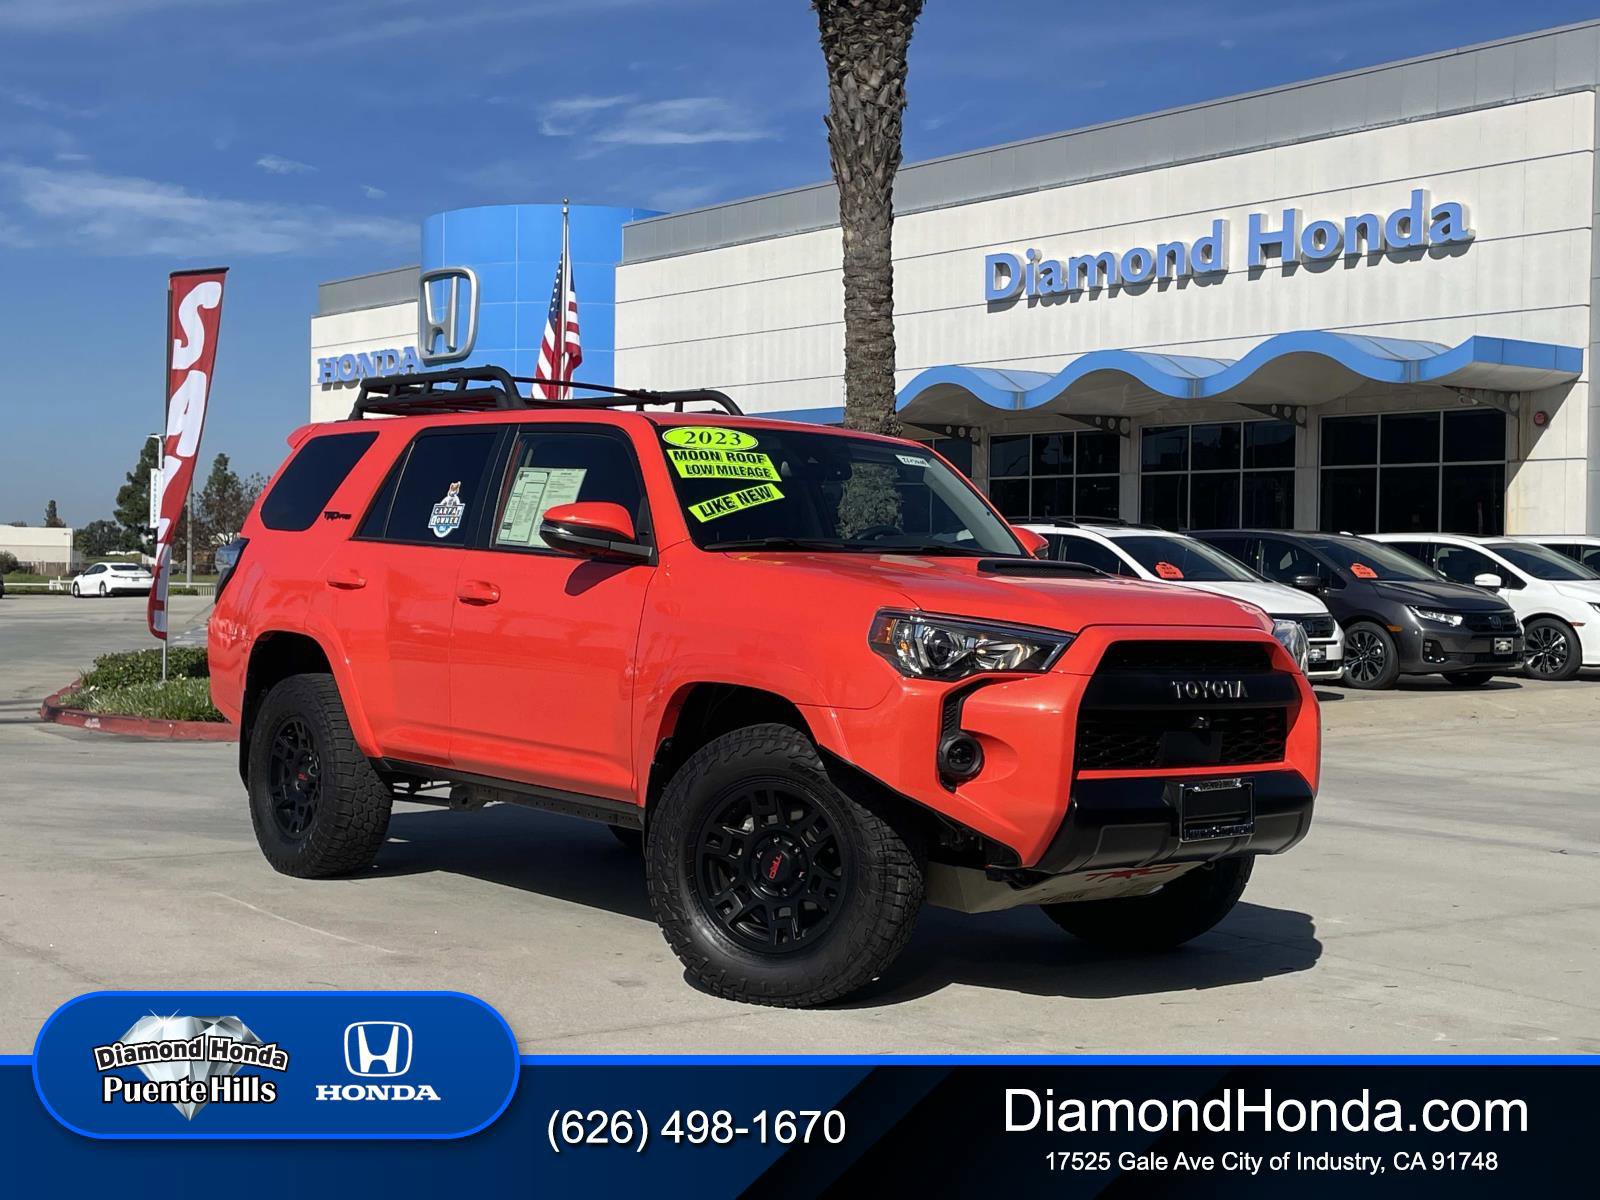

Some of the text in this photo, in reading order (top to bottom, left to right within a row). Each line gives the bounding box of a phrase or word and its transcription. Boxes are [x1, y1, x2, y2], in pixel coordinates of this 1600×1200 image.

[984, 188, 1474, 302] Diamond Honda
[317, 346, 421, 384] HONDA
[684, 431, 742, 446] 2023
[674, 450, 765, 464] MOON ROOF
[686, 464, 773, 479] LOW MILEAGE
[699, 485, 774, 518] LIKE NEW
[1172, 680, 1249, 699] TOYOTA
